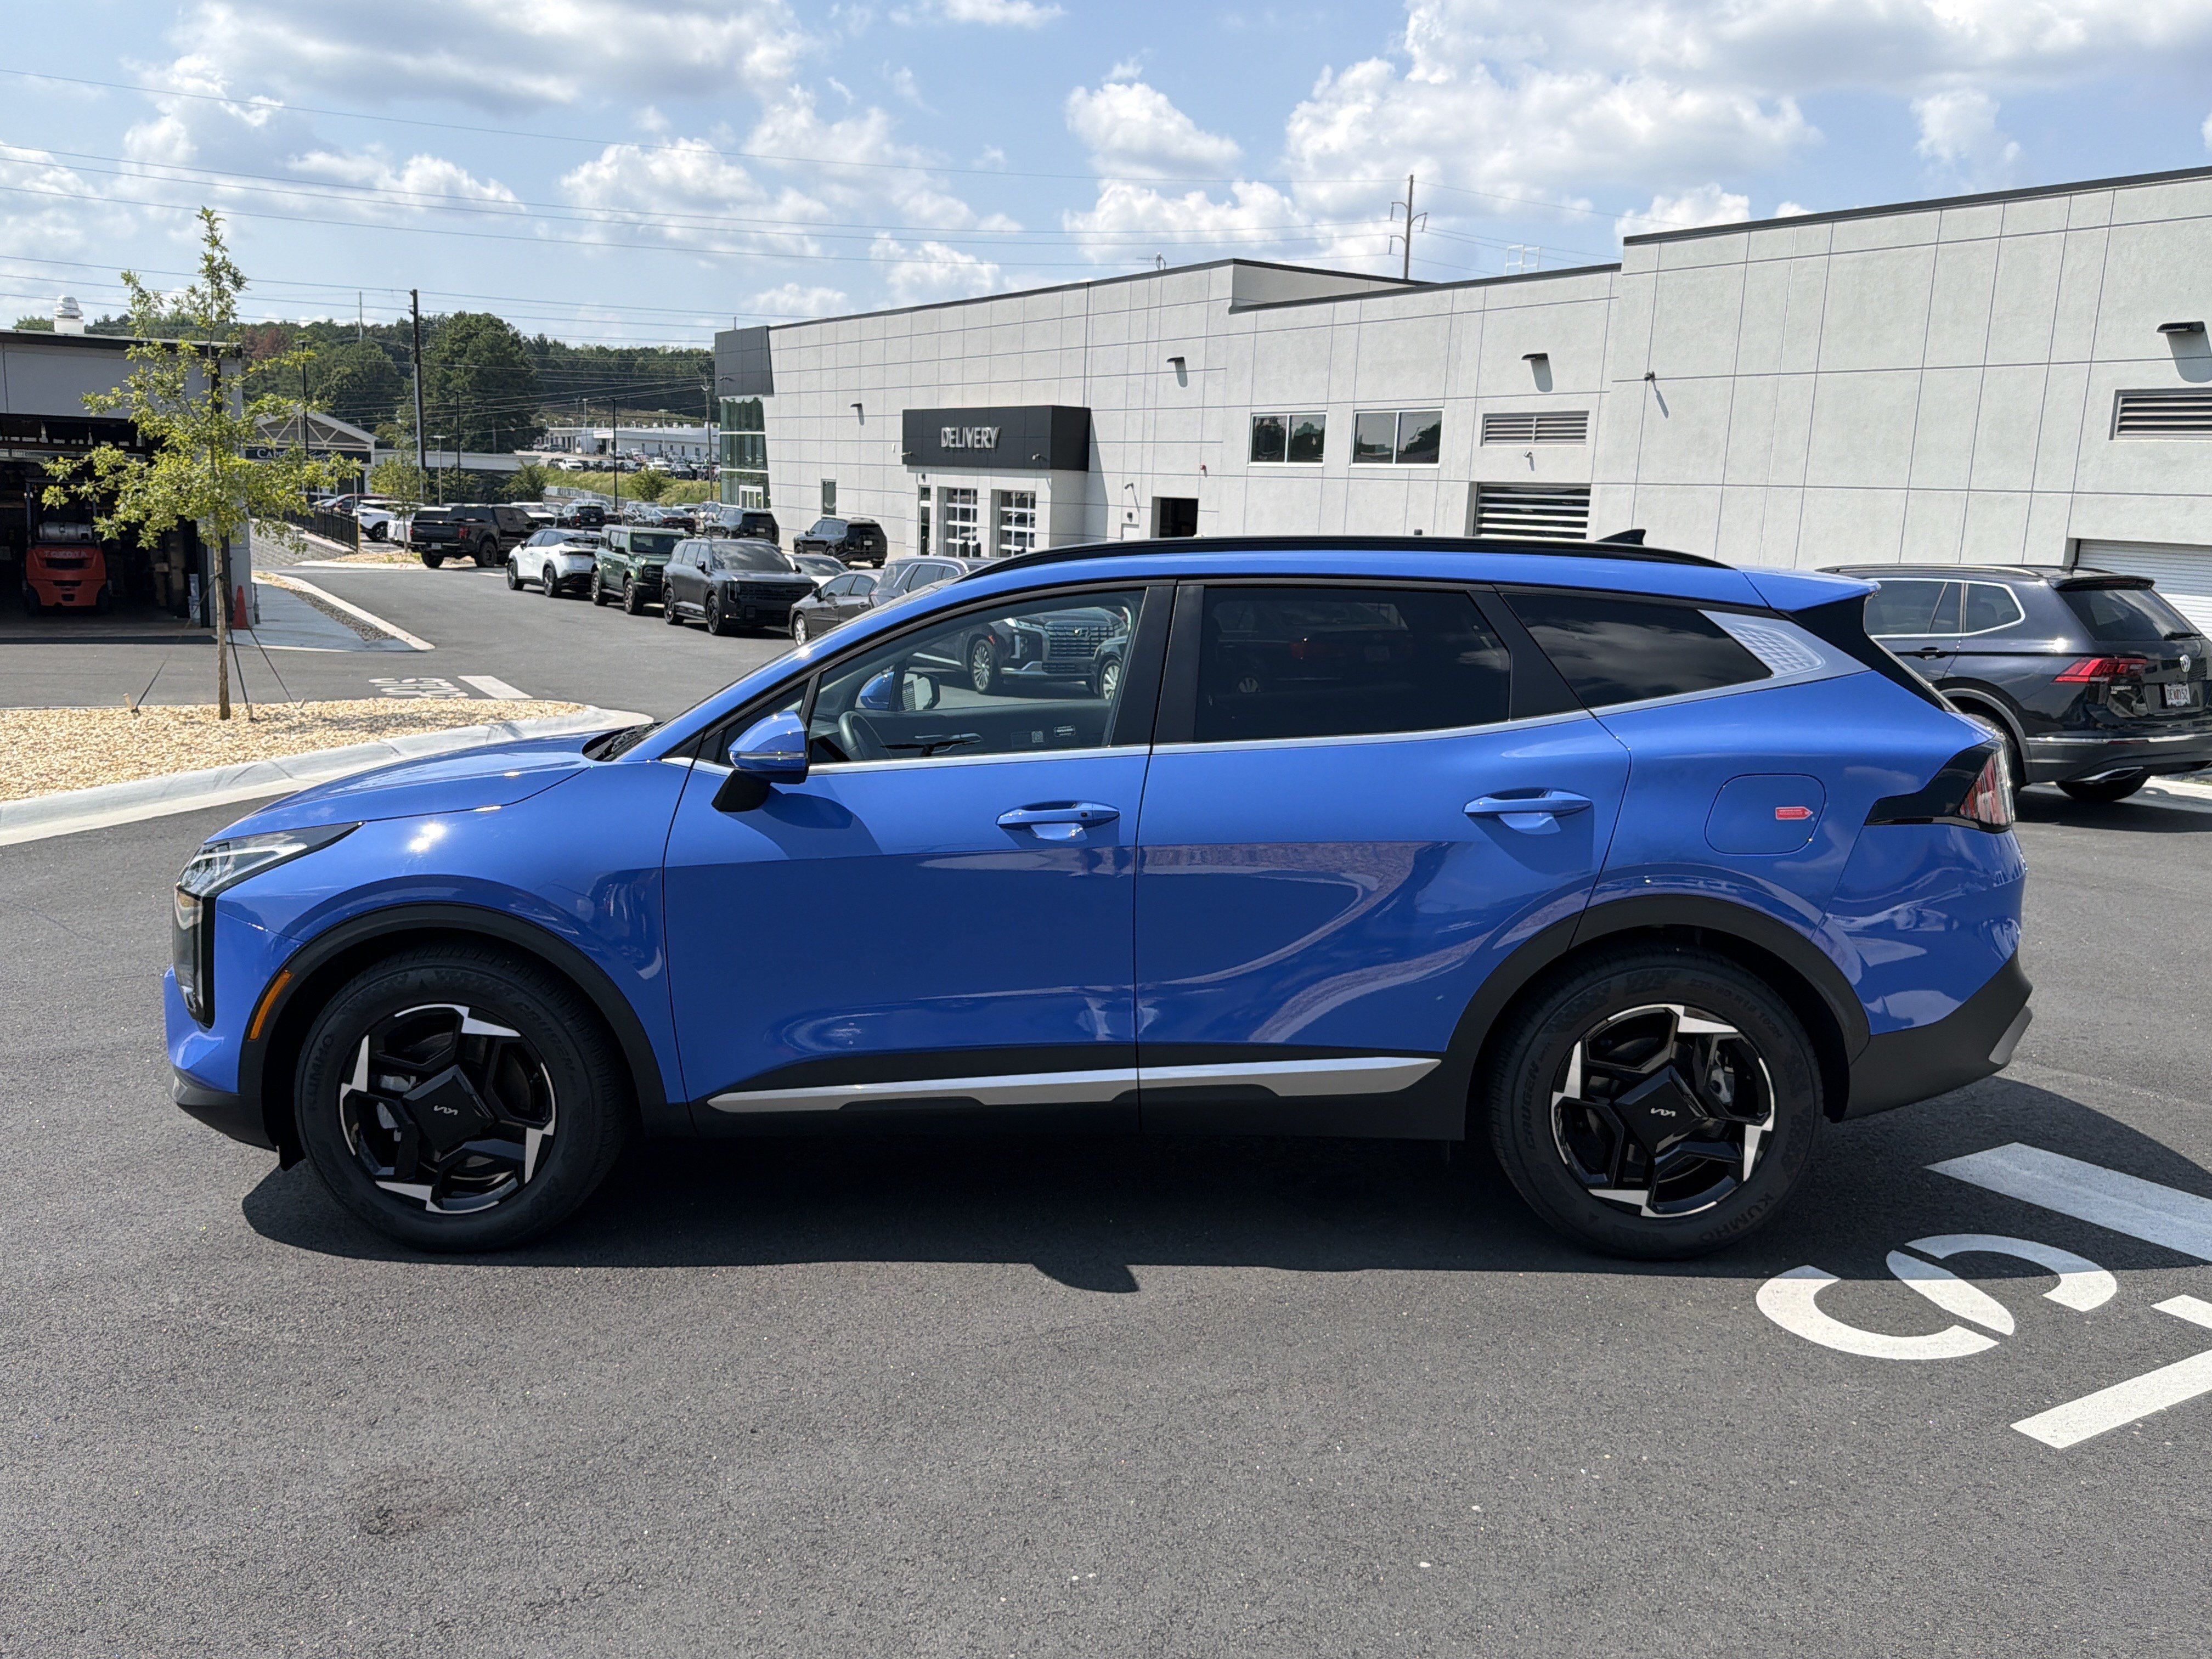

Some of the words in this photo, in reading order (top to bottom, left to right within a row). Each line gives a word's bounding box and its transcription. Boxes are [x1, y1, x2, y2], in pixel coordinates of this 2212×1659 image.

[941, 427, 1000, 448] DELIVERY
[44, 550, 87, 559] TOYOTA
[368, 678, 469, 698] STOP
[306, 1033, 335, 1111] KUMHO
[1700, 1192, 1774, 1241] KUMHO
